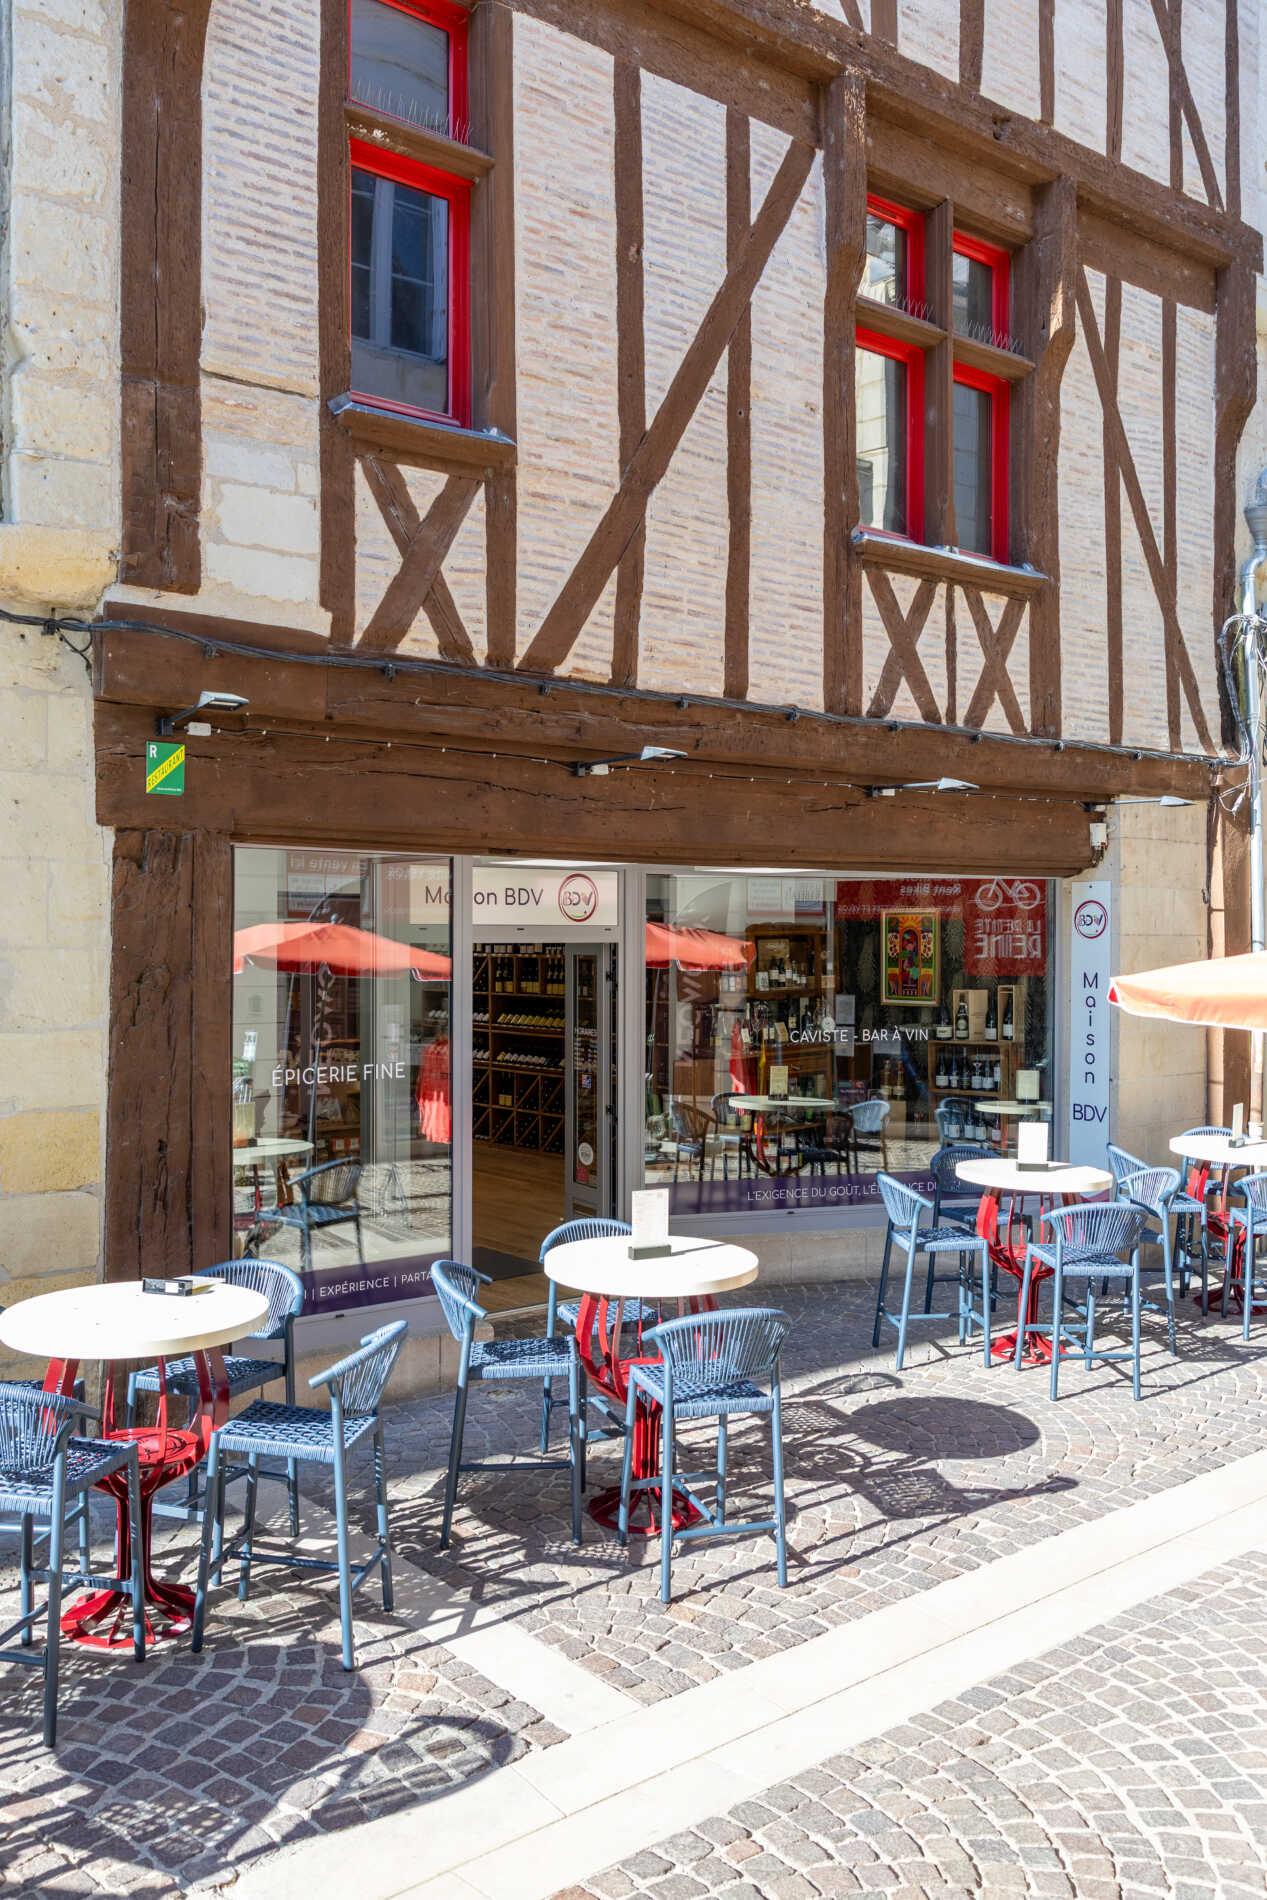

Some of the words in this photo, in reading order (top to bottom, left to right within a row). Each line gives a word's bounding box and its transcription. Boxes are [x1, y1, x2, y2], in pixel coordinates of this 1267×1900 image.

[149, 744, 158, 758] R
[505, 887, 544, 906] BDV
[790, 1029, 849, 1043] CAVISTE
[862, 1028, 888, 1042] BAR
[892, 1025, 902, 1041] À
[905, 1028, 929, 1041] VIN
[1083, 972, 1099, 1084] Maison
[271, 1064, 358, 1087] ÉPICERIE
[363, 1062, 406, 1081] FINE
[1072, 1103, 1108, 1124] BDV
[747, 1188, 809, 1201] L'EXIGENCE
[811, 1186, 827, 1198] DU
[319, 1276, 390, 1298] EXPÉRIENCE
